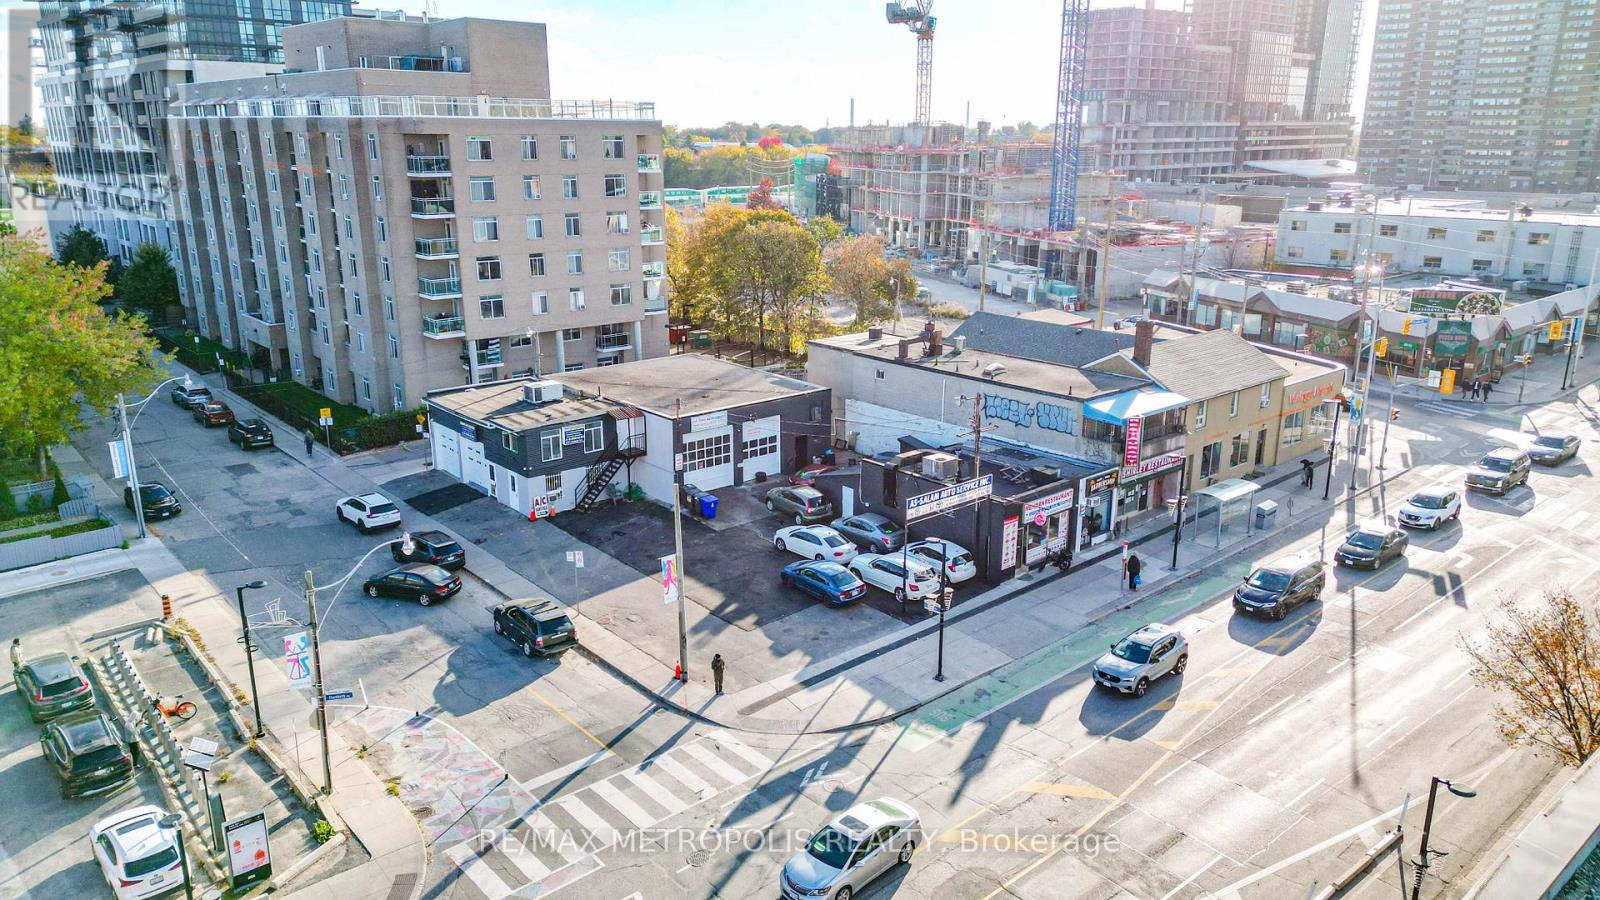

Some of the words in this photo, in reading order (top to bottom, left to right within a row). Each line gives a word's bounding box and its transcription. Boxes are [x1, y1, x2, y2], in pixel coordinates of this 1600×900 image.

[909, 491, 940, 509] AS-SALAM
[940, 487, 956, 499] AUTO
[956, 482, 979, 494] SERVICE
[979, 477, 991, 487] INC.
